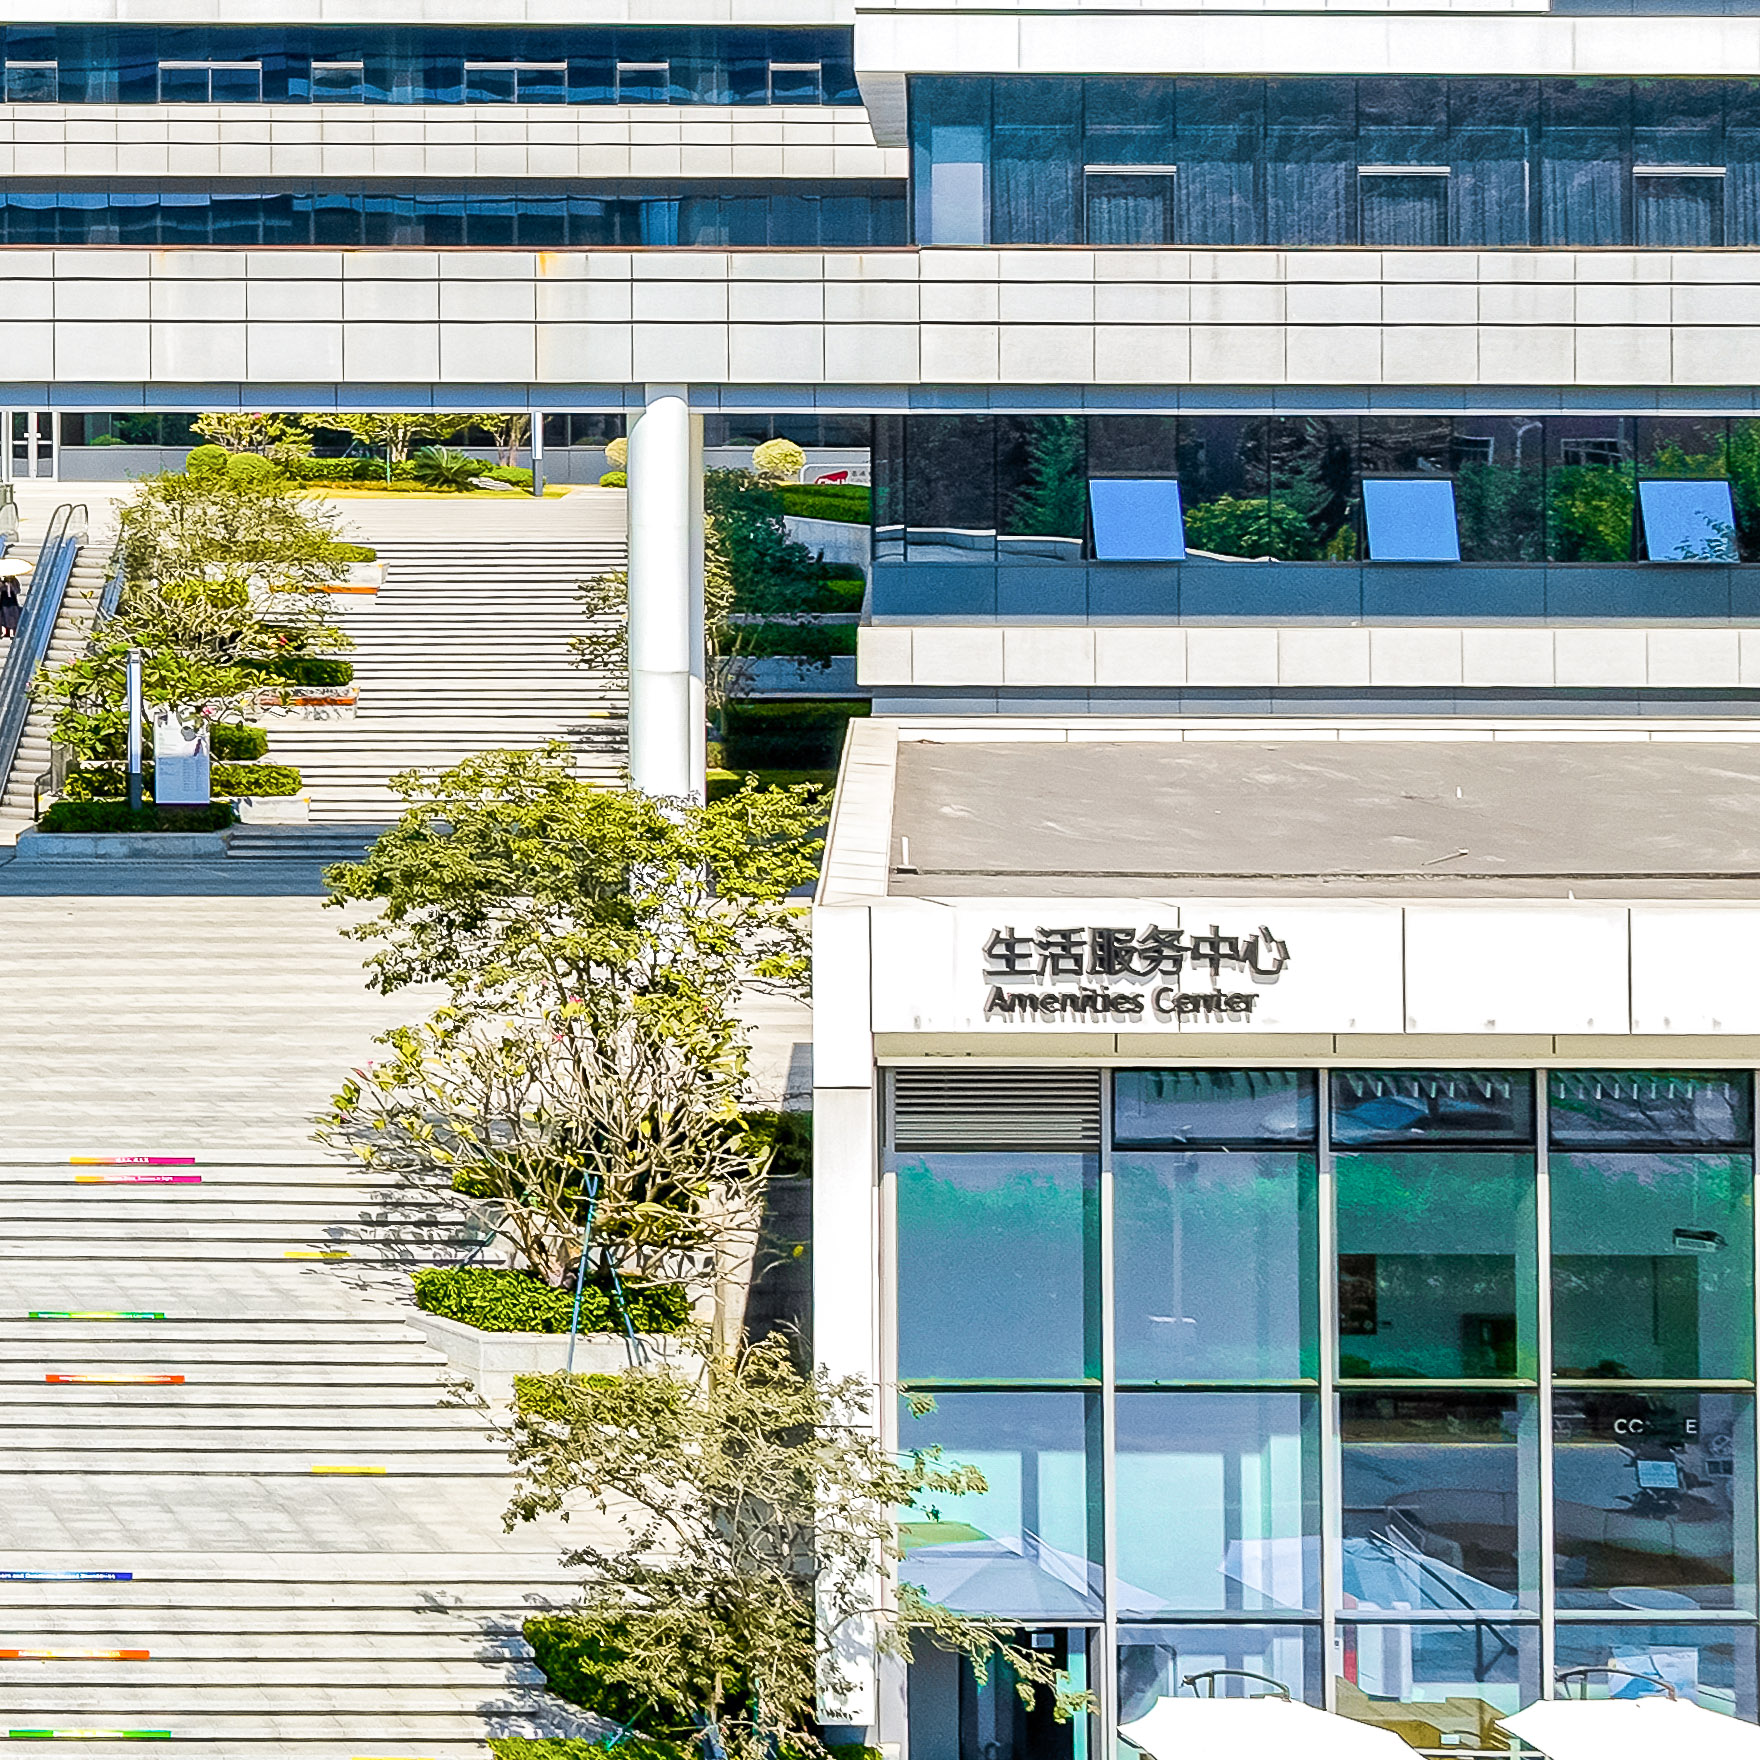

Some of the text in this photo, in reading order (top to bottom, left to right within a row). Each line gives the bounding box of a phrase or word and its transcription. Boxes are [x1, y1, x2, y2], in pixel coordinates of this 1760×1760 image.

[982, 924, 1290, 980] 生活服务中心
[984, 985, 1259, 1014] Amenities Center
